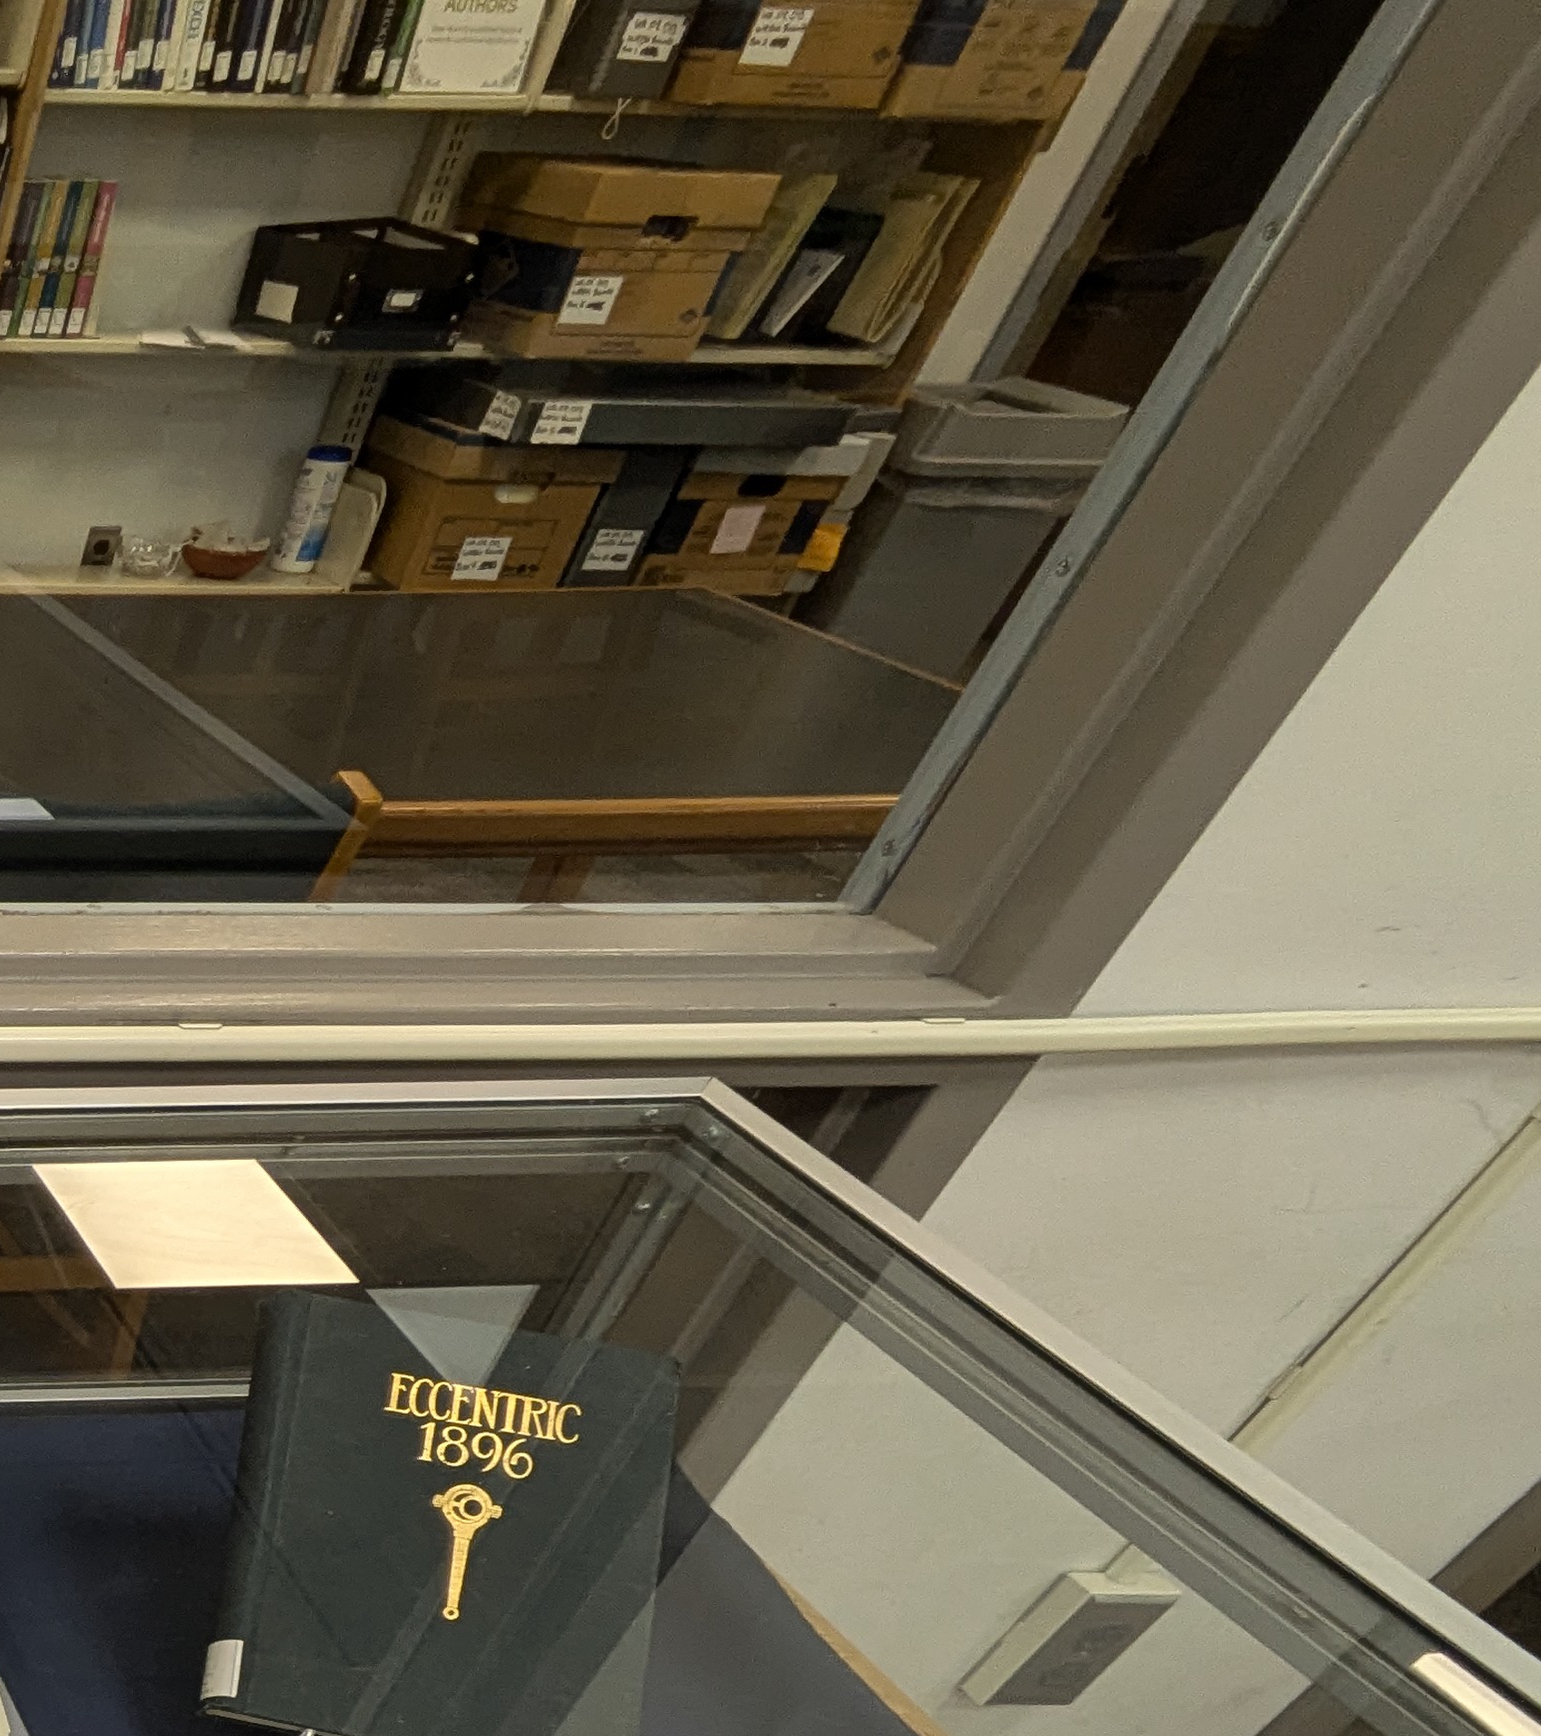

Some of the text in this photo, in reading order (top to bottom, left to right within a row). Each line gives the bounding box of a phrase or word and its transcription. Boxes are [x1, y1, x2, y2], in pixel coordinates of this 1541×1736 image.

[444, 0, 519, 14] AUTHORS
[384, 1372, 582, 1444] ECCENTRIC
[417, 1421, 534, 1480] 1896
